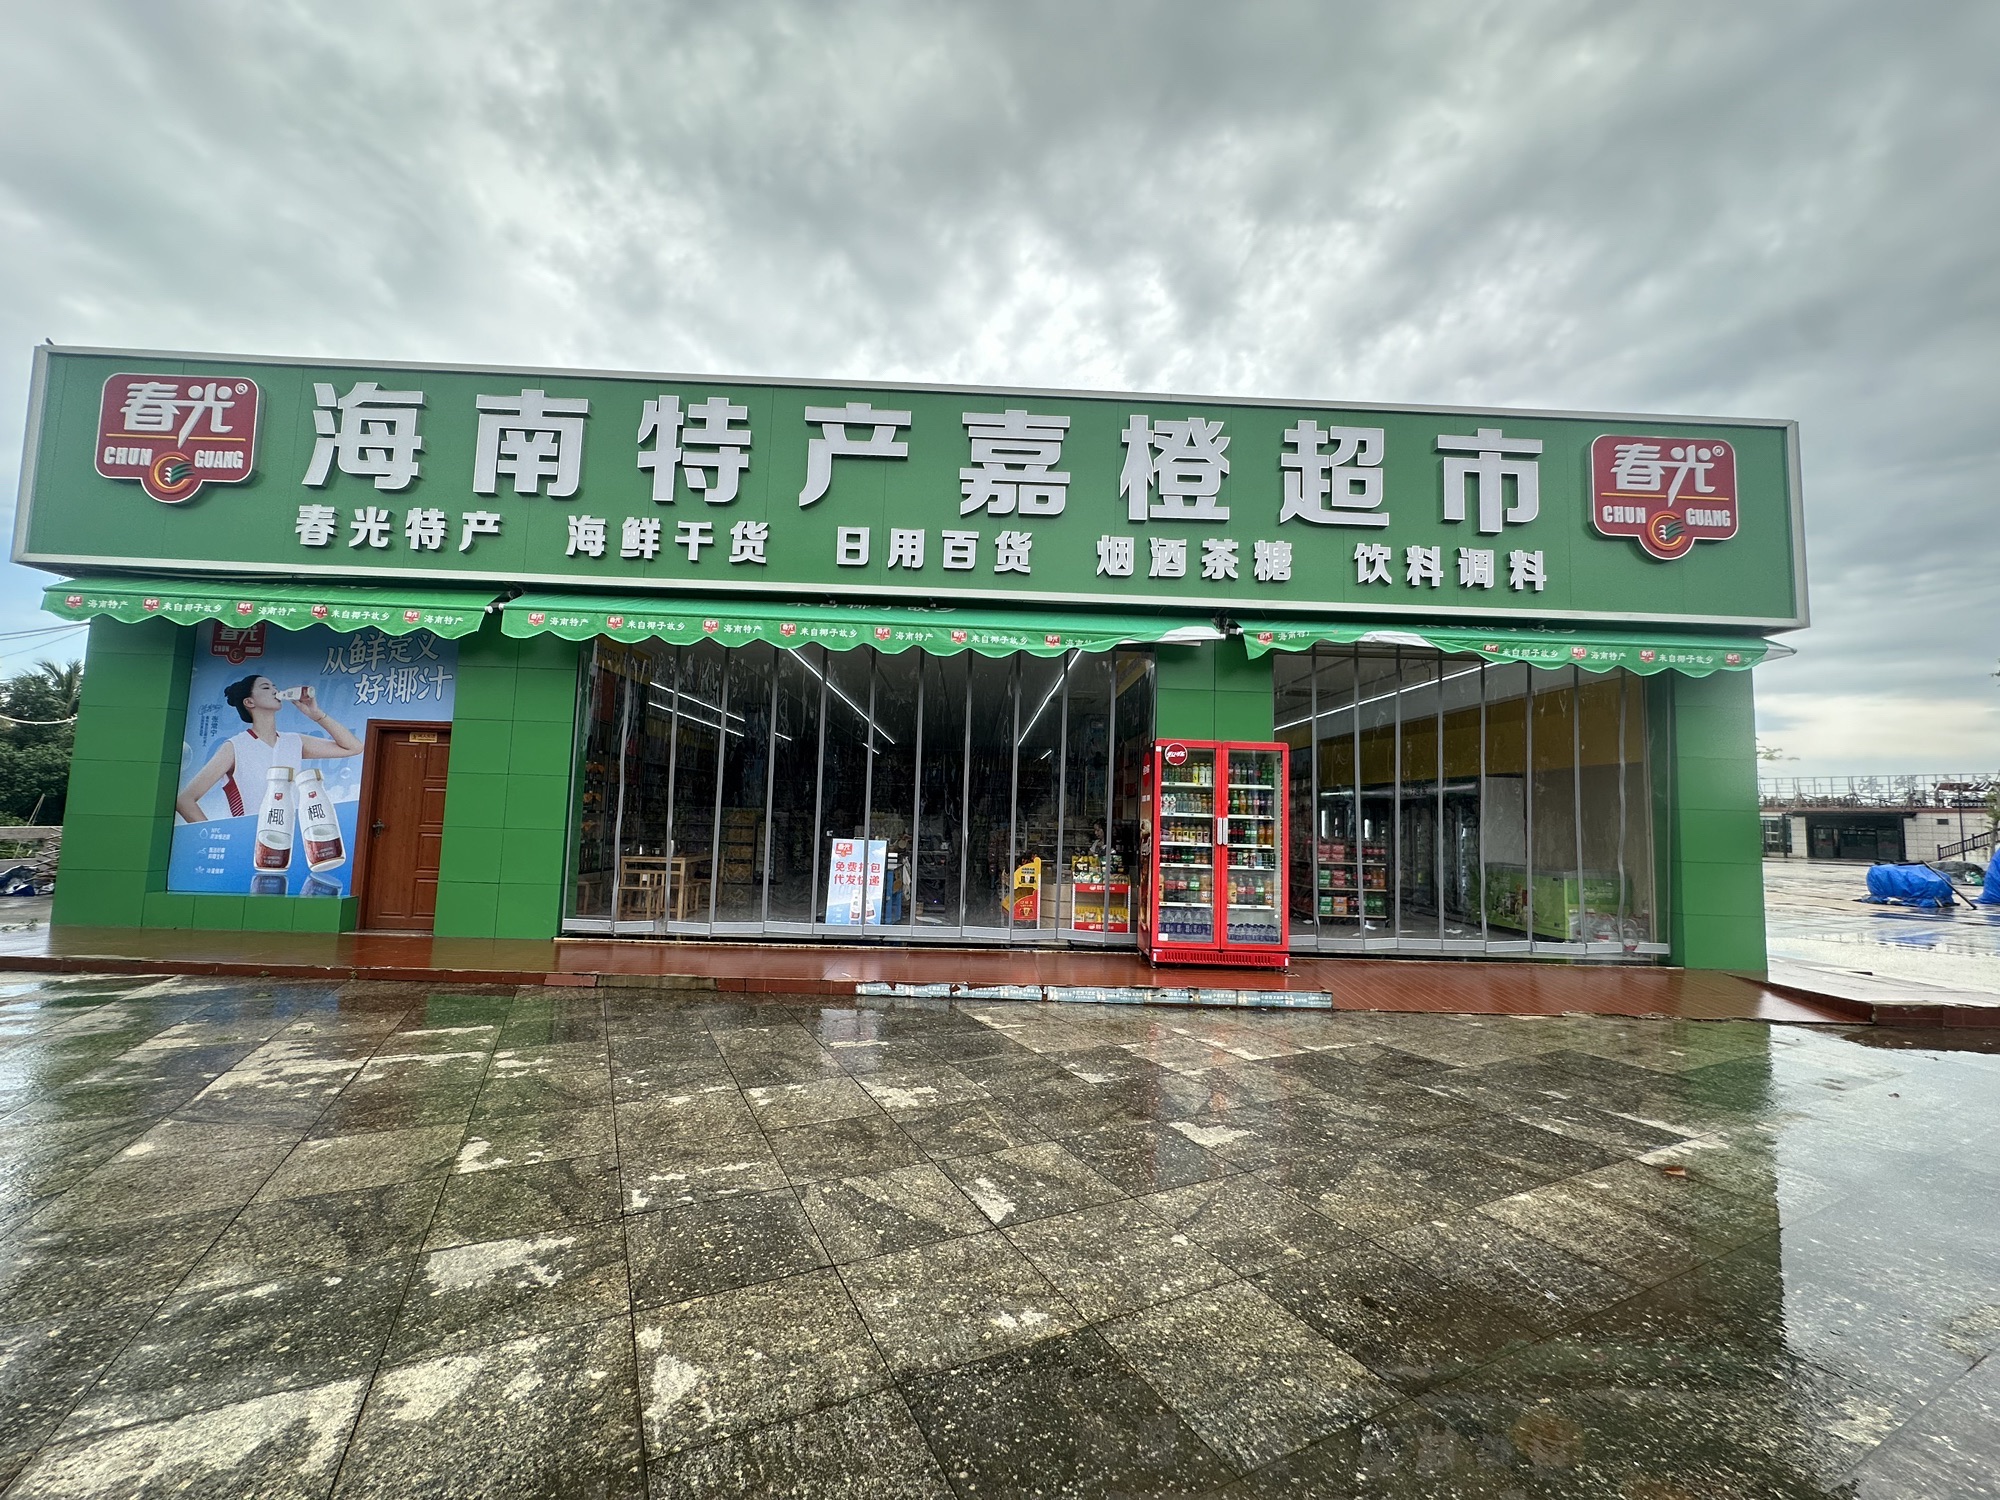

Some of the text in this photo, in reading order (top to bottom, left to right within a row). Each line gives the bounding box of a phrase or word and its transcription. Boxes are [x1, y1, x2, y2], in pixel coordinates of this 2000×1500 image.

[119, 381, 235, 449] 春光
[103, 447, 243, 470] CHUN GUANG
[301, 381, 1543, 534] 海南特产嘉橙超市
[1610, 442, 1715, 508] 春光
[1602, 504, 1731, 528] CHUN GUANG
[294, 503, 1548, 592] 春光特产 海鲜干货 日用百货 烟酒茶糖 饮料调料
[320, 631, 439, 675] 从鲜定义
[354, 664, 453, 706] 好椰汁
